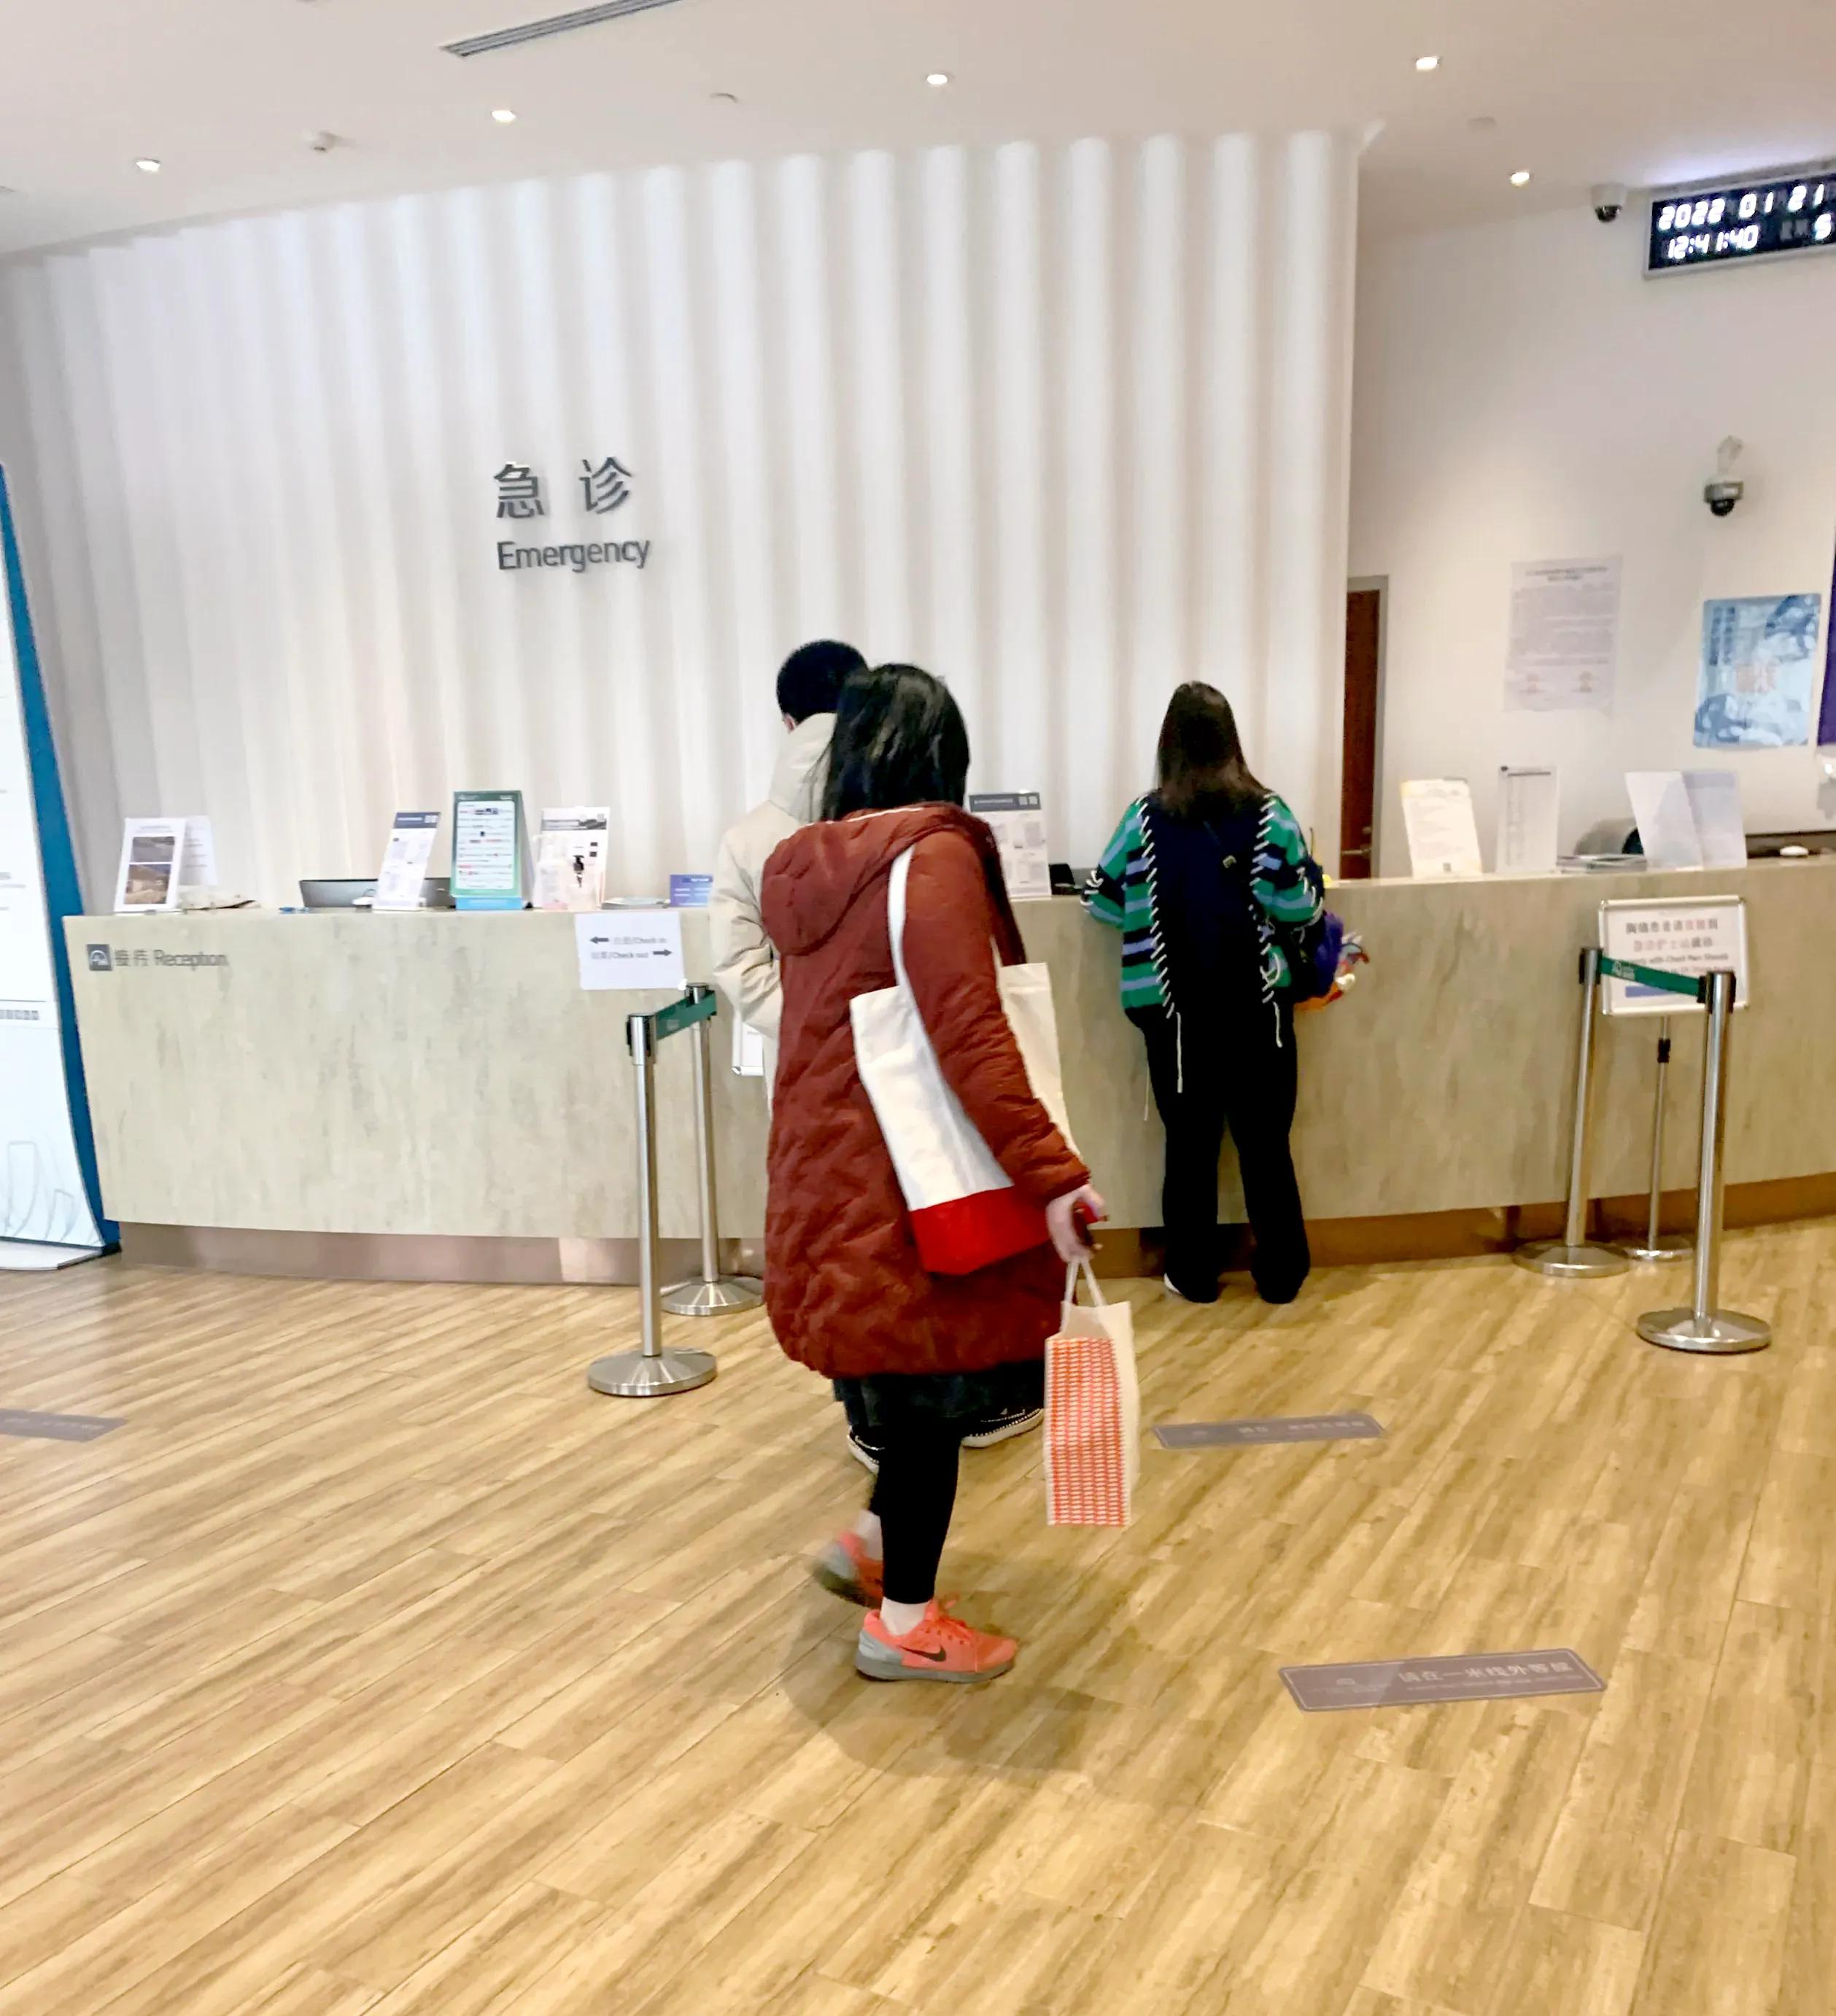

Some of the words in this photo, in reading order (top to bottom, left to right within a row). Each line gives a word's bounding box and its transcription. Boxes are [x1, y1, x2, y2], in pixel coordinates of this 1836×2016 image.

[1659, 198, 1726, 230] 2022
[1739, 192, 1774, 219] 01
[1787, 184, 1824, 212] 21
[1667, 225, 1759, 259] 12:41:40
[497, 540, 650, 573] Emergency
[153, 949, 228, 971] Reception
